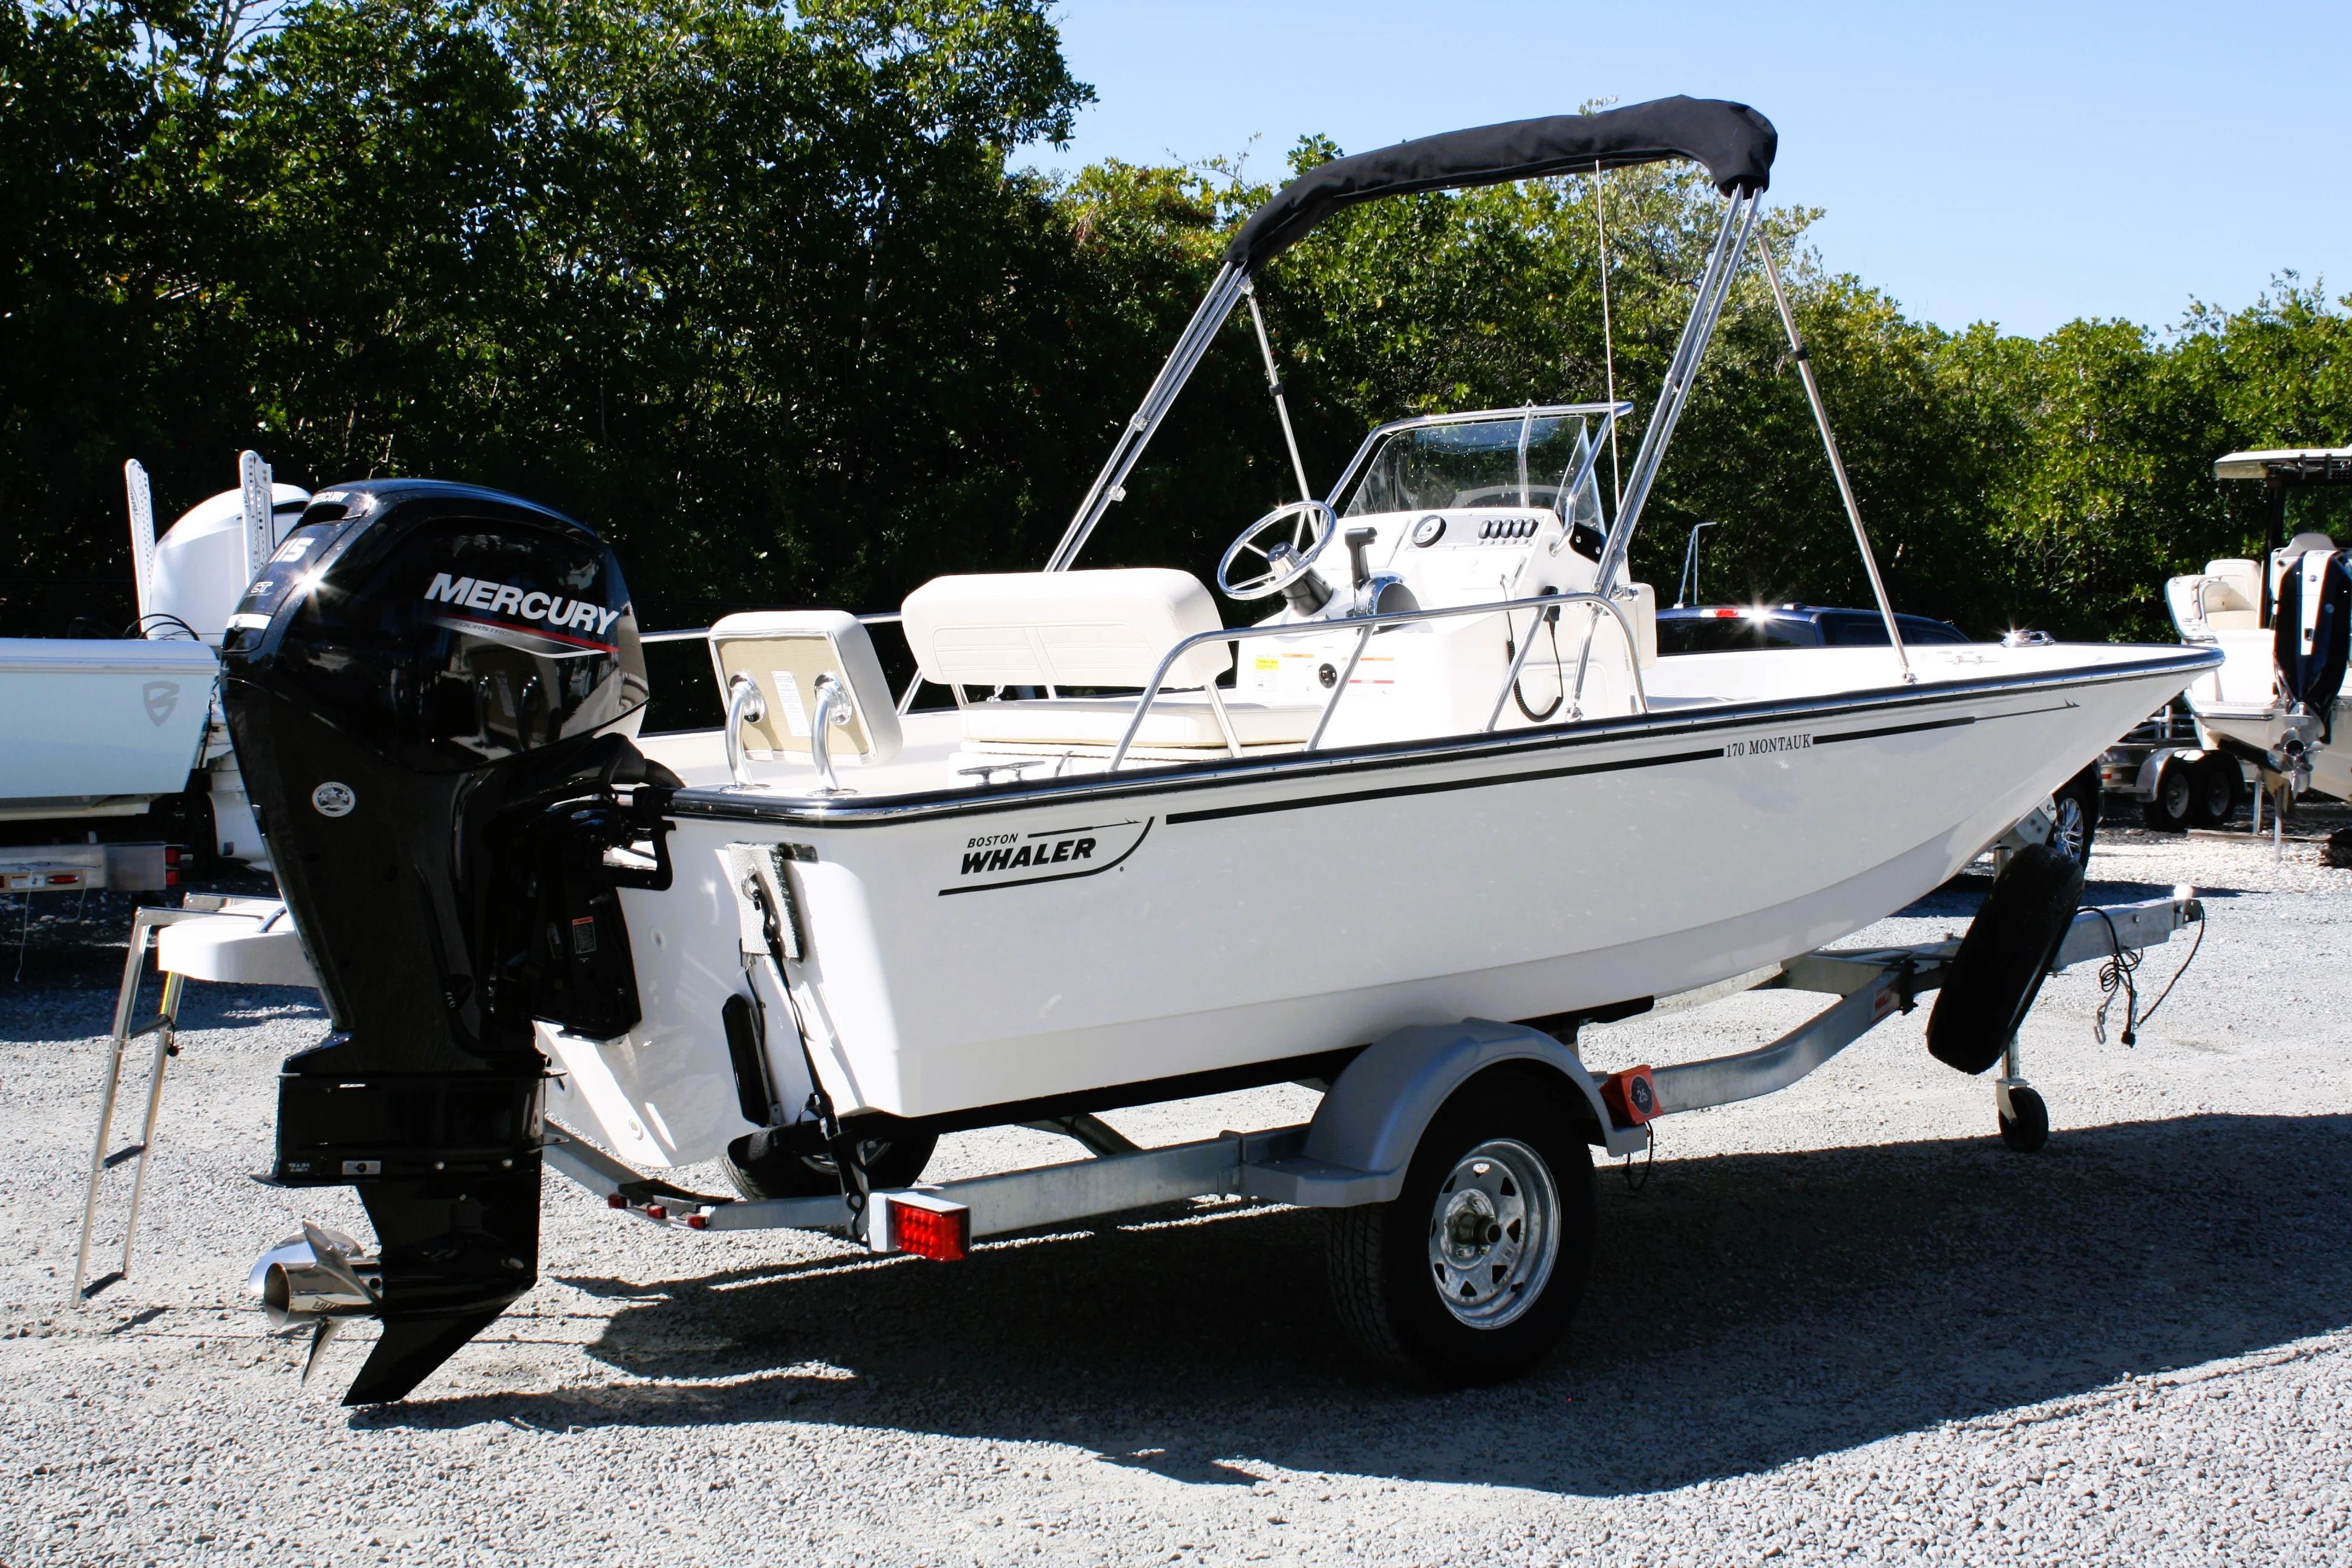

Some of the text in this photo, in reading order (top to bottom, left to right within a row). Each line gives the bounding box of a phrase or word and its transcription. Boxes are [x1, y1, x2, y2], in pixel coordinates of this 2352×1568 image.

[424, 572, 619, 635] MERCURY
[452, 620, 519, 637] FOURSTRO
[1726, 734, 1811, 757] 170 MONTAUK
[967, 833, 1018, 848] BOSTON
[961, 838, 1096, 875] WHALER
